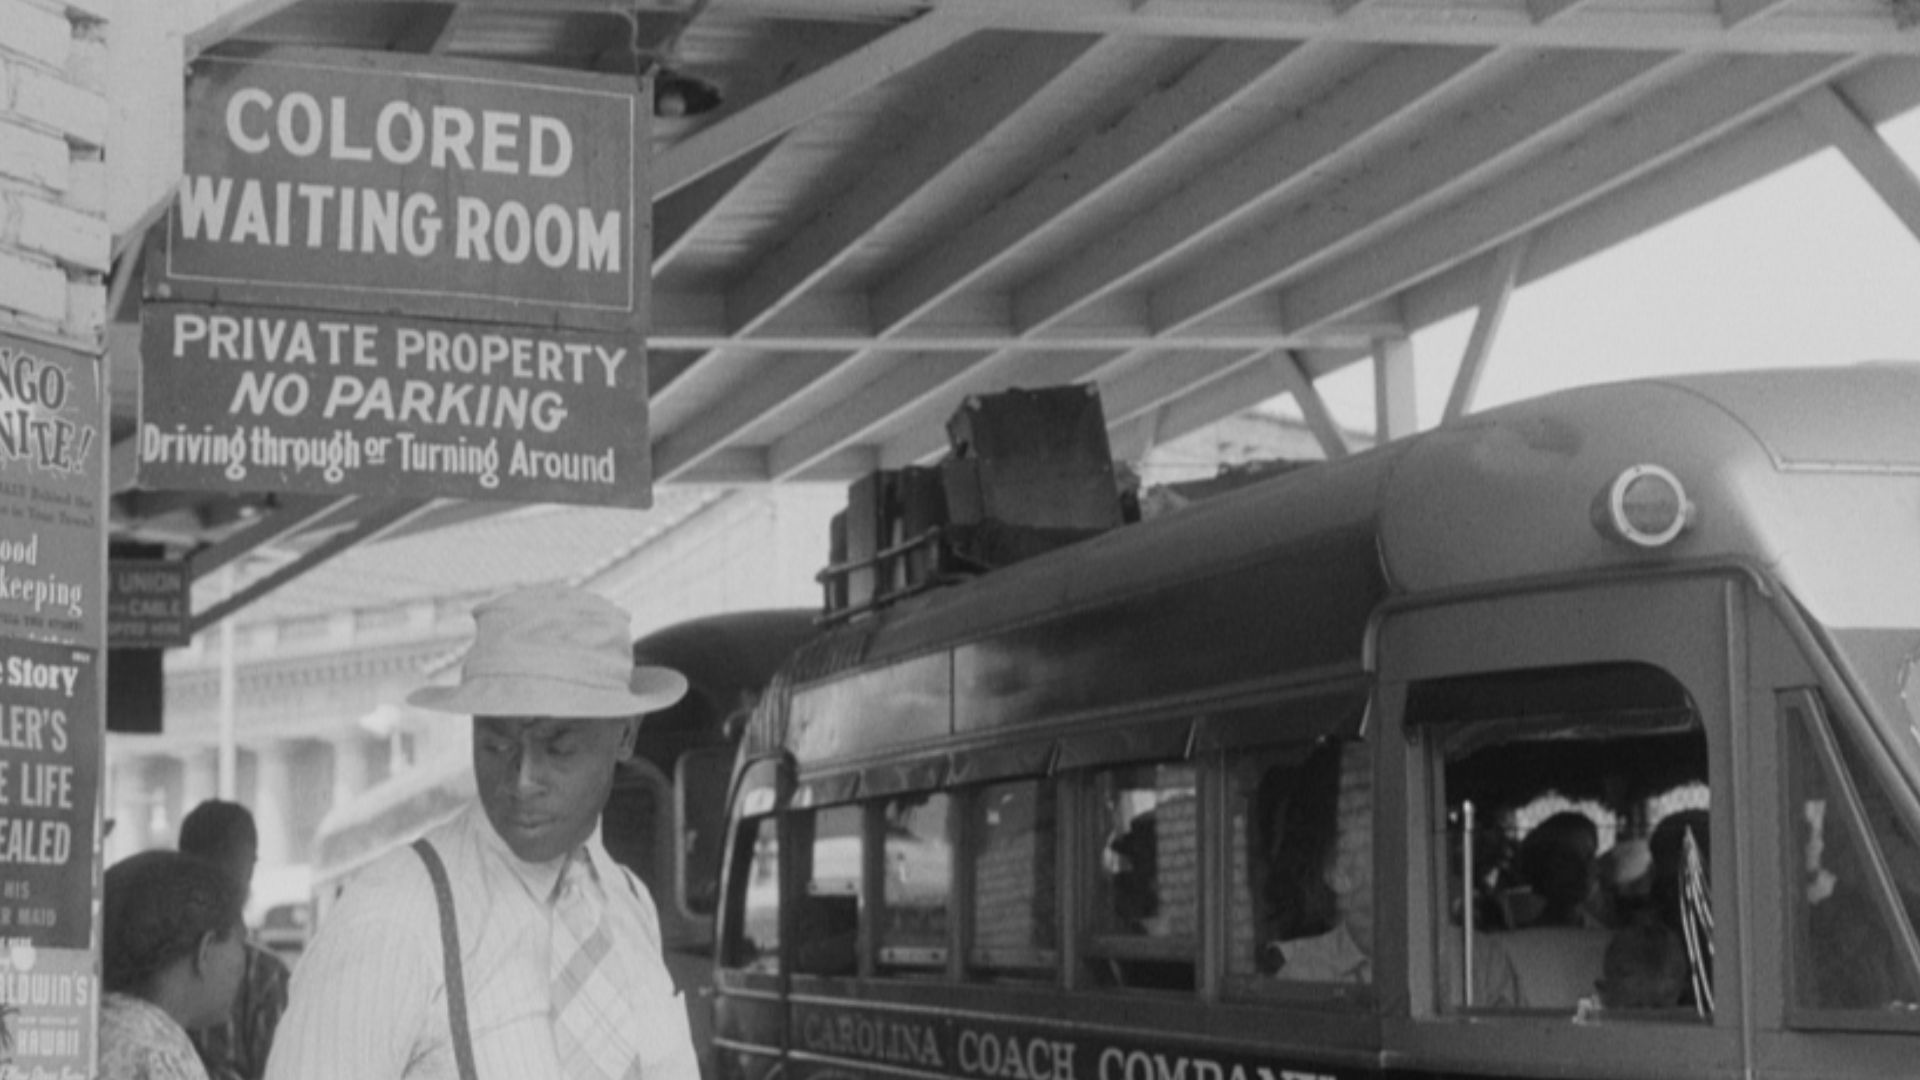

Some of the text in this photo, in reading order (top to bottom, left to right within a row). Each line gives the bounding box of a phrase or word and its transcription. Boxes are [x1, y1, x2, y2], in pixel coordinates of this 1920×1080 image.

[226, 88, 573, 177] COLORED
[178, 175, 621, 272] WAITING ROOM
[173, 314, 627, 387] PRIVATE PROPERTY
[228, 371, 567, 432] NO PARKING
[143, 423, 615, 489] Driving through or Turning Around
[0, 559, 83, 618] keeping
[7, 656, 79, 698] Story
[21, 762, 73, 809] LIFE
[18, 908, 57, 928] MAID
[803, 1013, 943, 1066] CAROLINA
[958, 1030, 1076, 1080] COACH
